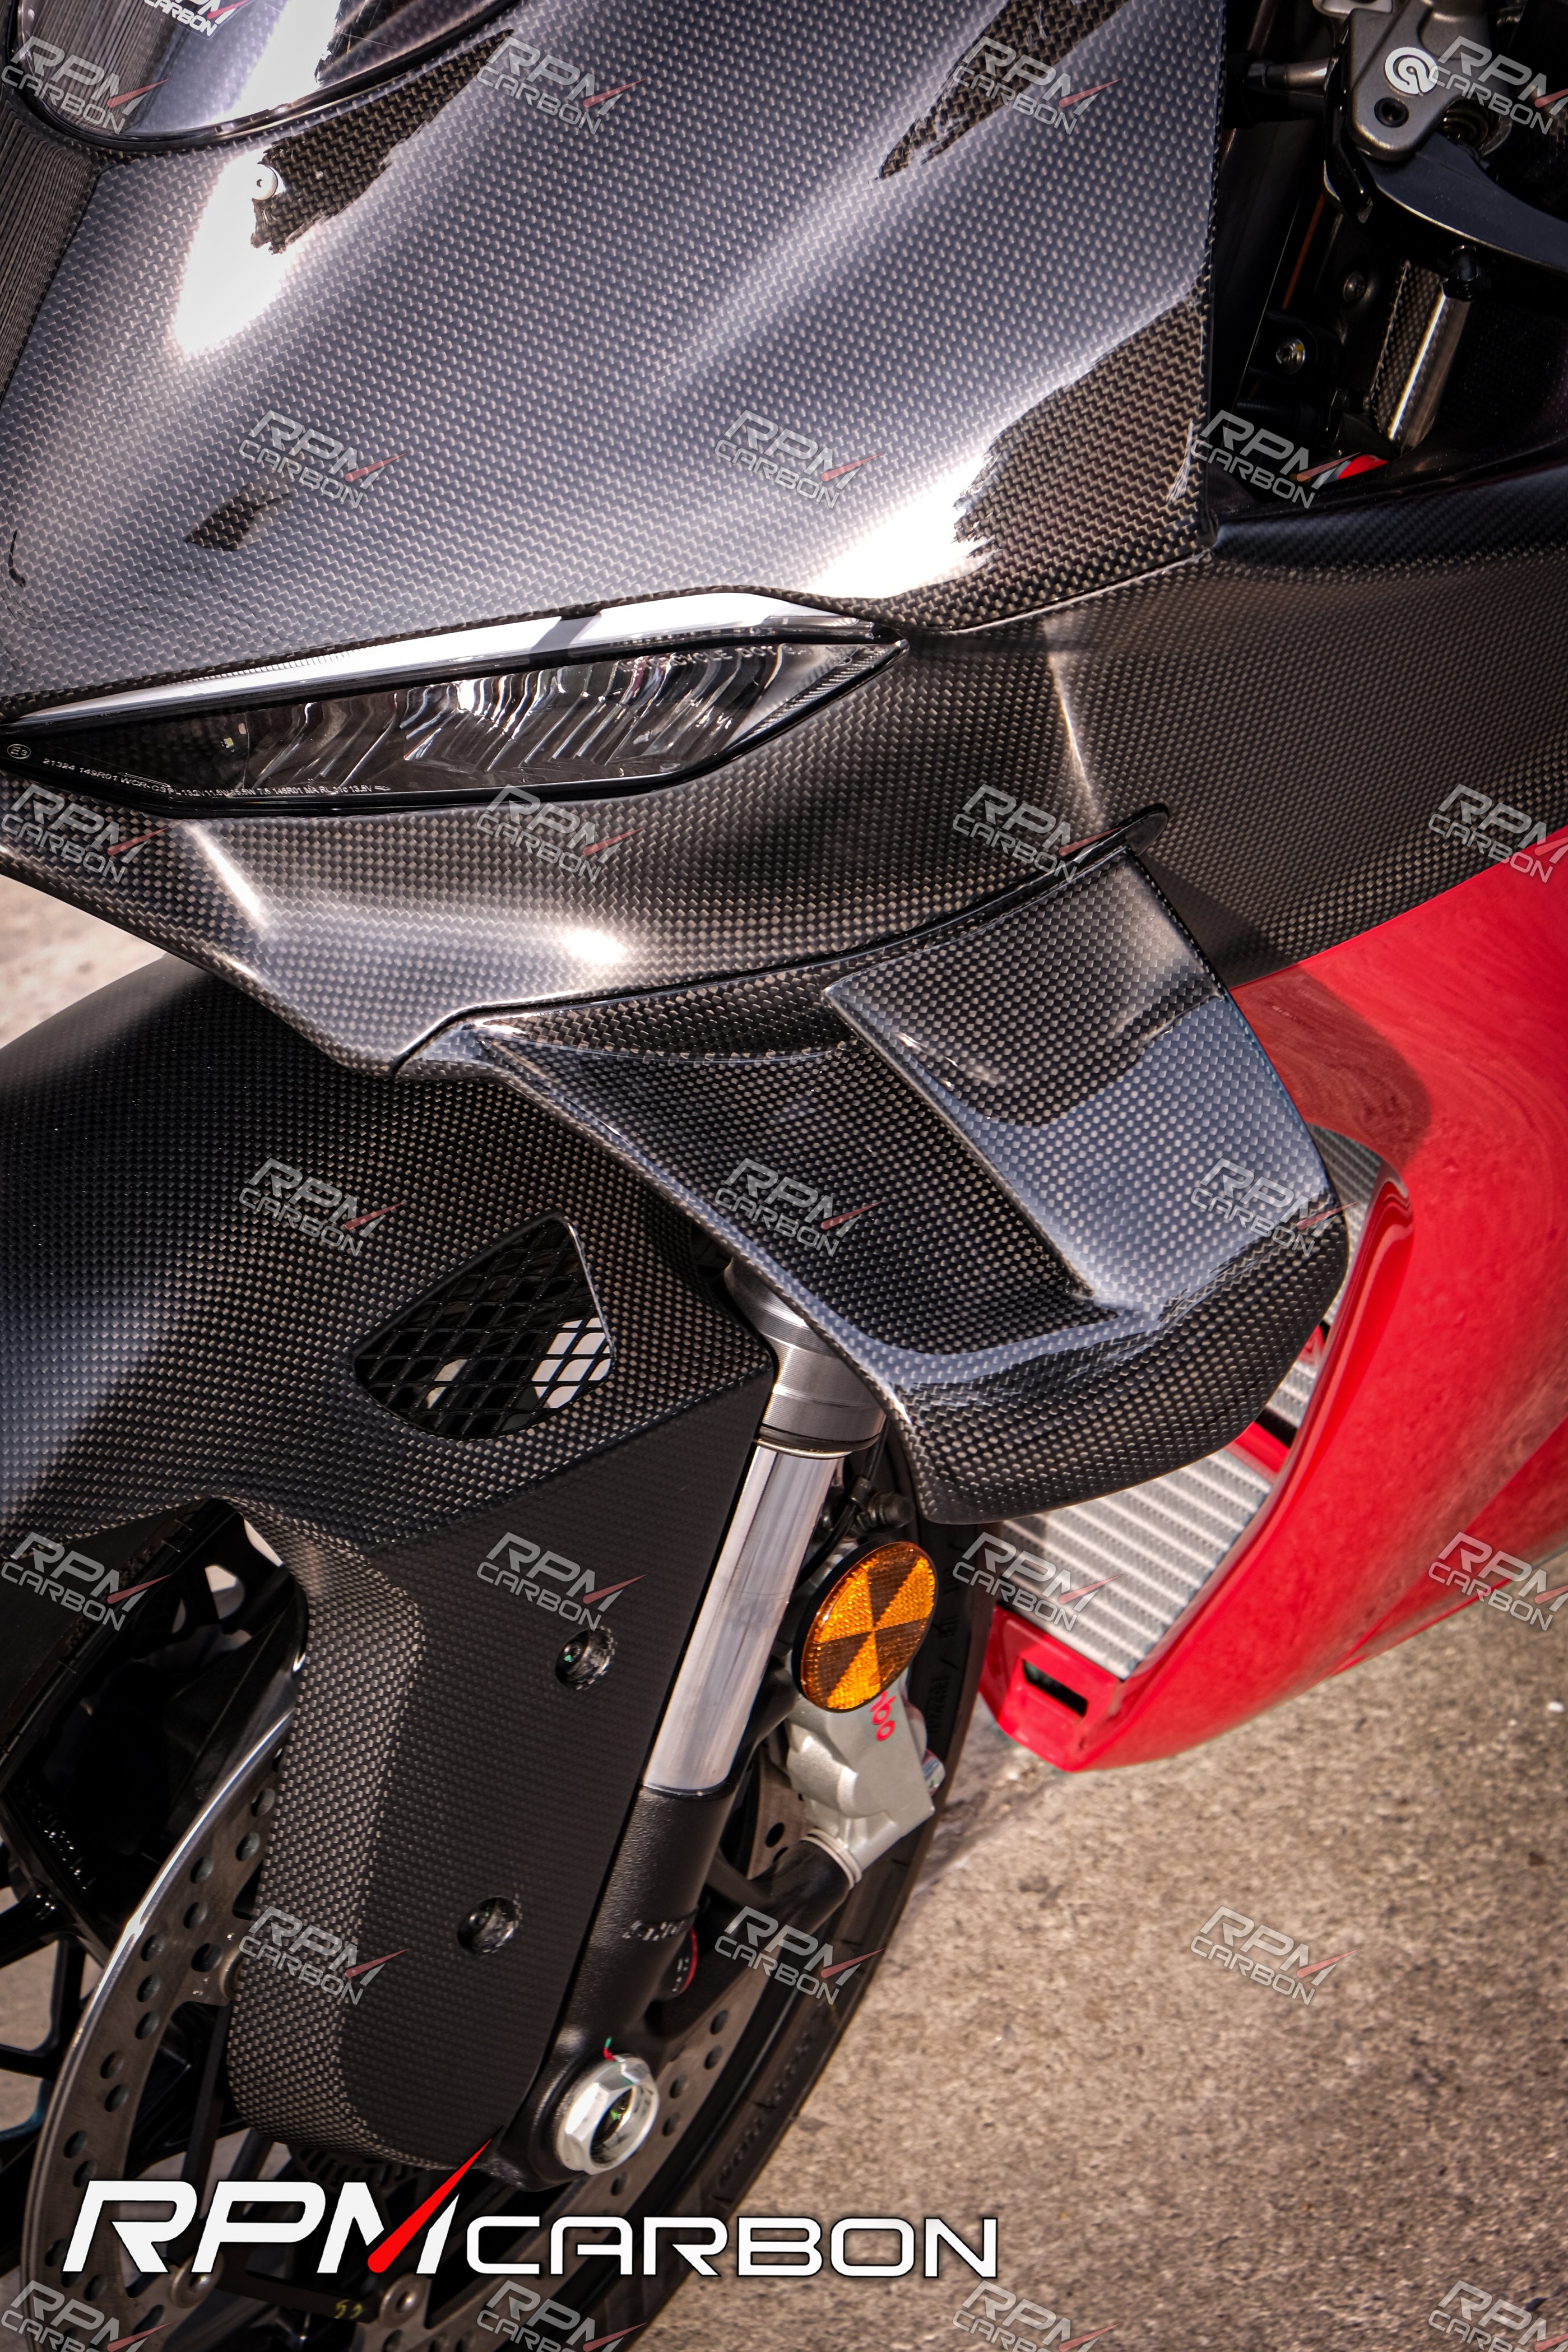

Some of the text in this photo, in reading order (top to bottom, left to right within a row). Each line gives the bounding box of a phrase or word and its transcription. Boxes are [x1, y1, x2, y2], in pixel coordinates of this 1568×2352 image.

[735, 646, 777, 658] DOT
[10, 746, 28, 757] E3
[43, 758, 75, 771] 21324
[80, 767, 118, 782] 149R01
